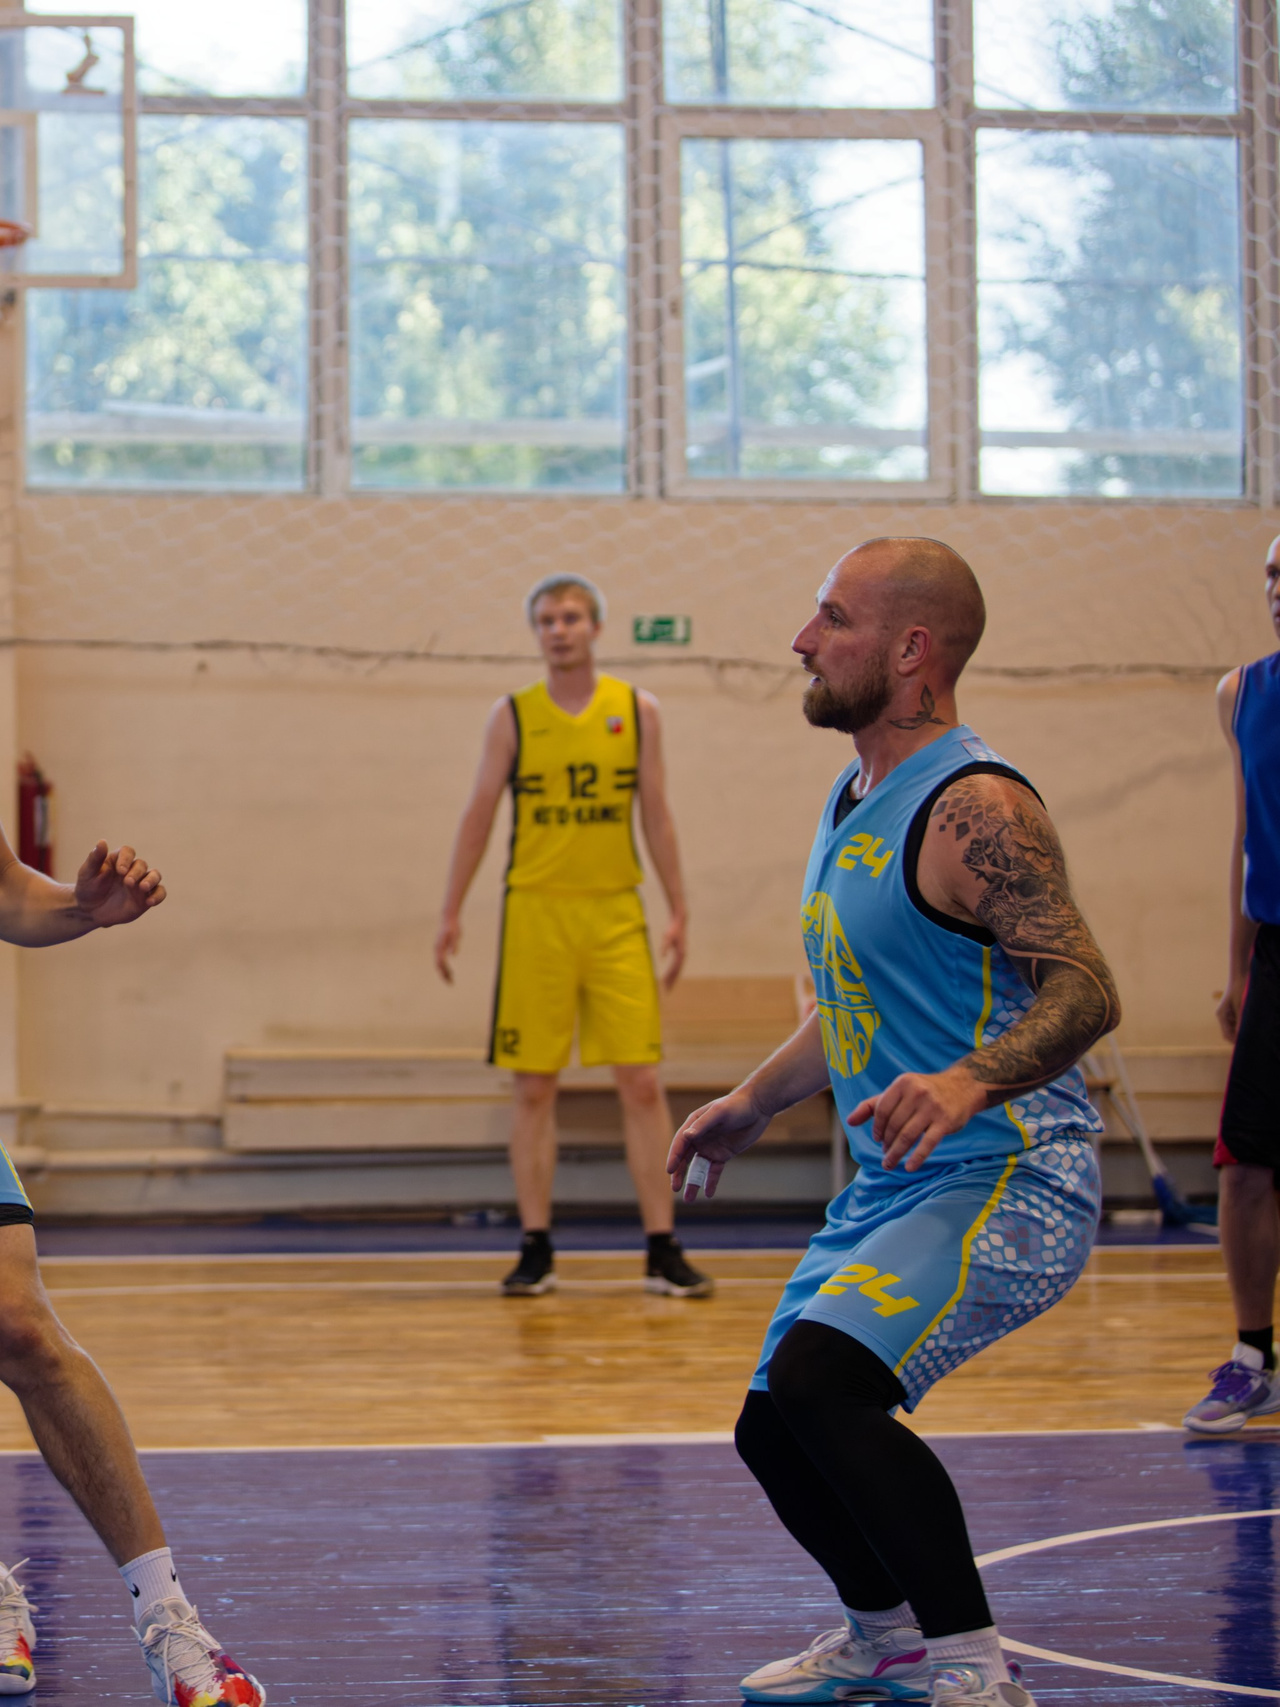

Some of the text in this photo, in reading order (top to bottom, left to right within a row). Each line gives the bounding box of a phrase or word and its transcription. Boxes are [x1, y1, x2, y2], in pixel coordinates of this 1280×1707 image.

[567, 763, 598, 798] 12
[835, 832, 894, 878] 24
[816, 1264, 920, 1317] 24
